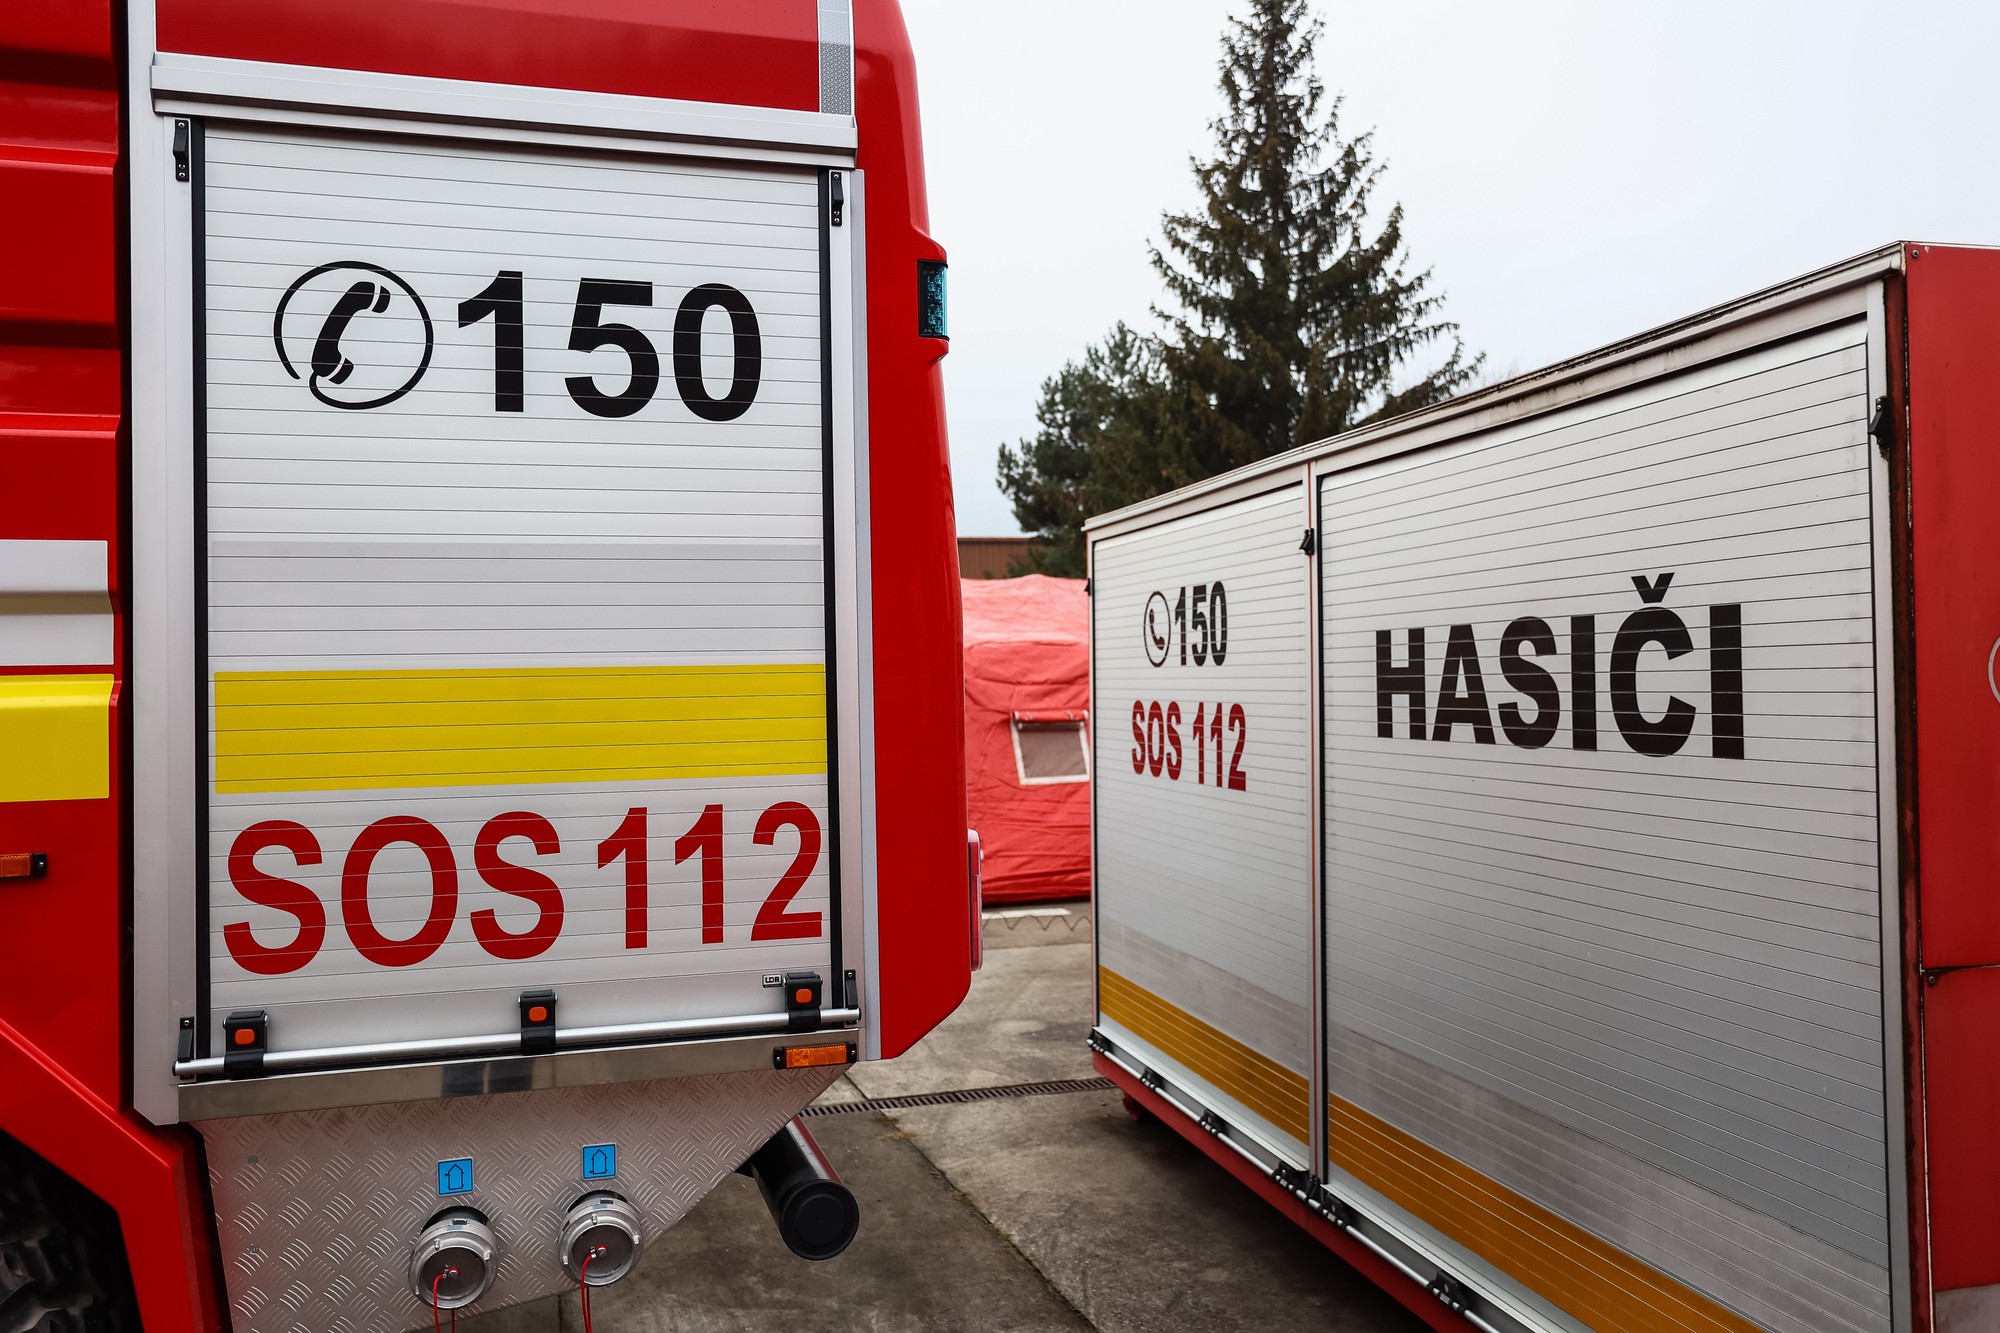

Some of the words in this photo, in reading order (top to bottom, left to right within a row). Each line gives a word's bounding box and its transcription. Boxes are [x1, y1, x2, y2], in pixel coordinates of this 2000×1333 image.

[457, 270, 762, 422] 150
[1174, 580, 1228, 667] 150
[1375, 572, 1746, 760] HASIČI
[1131, 700, 1182, 781] SOS
[1192, 701, 1246, 792] 112
